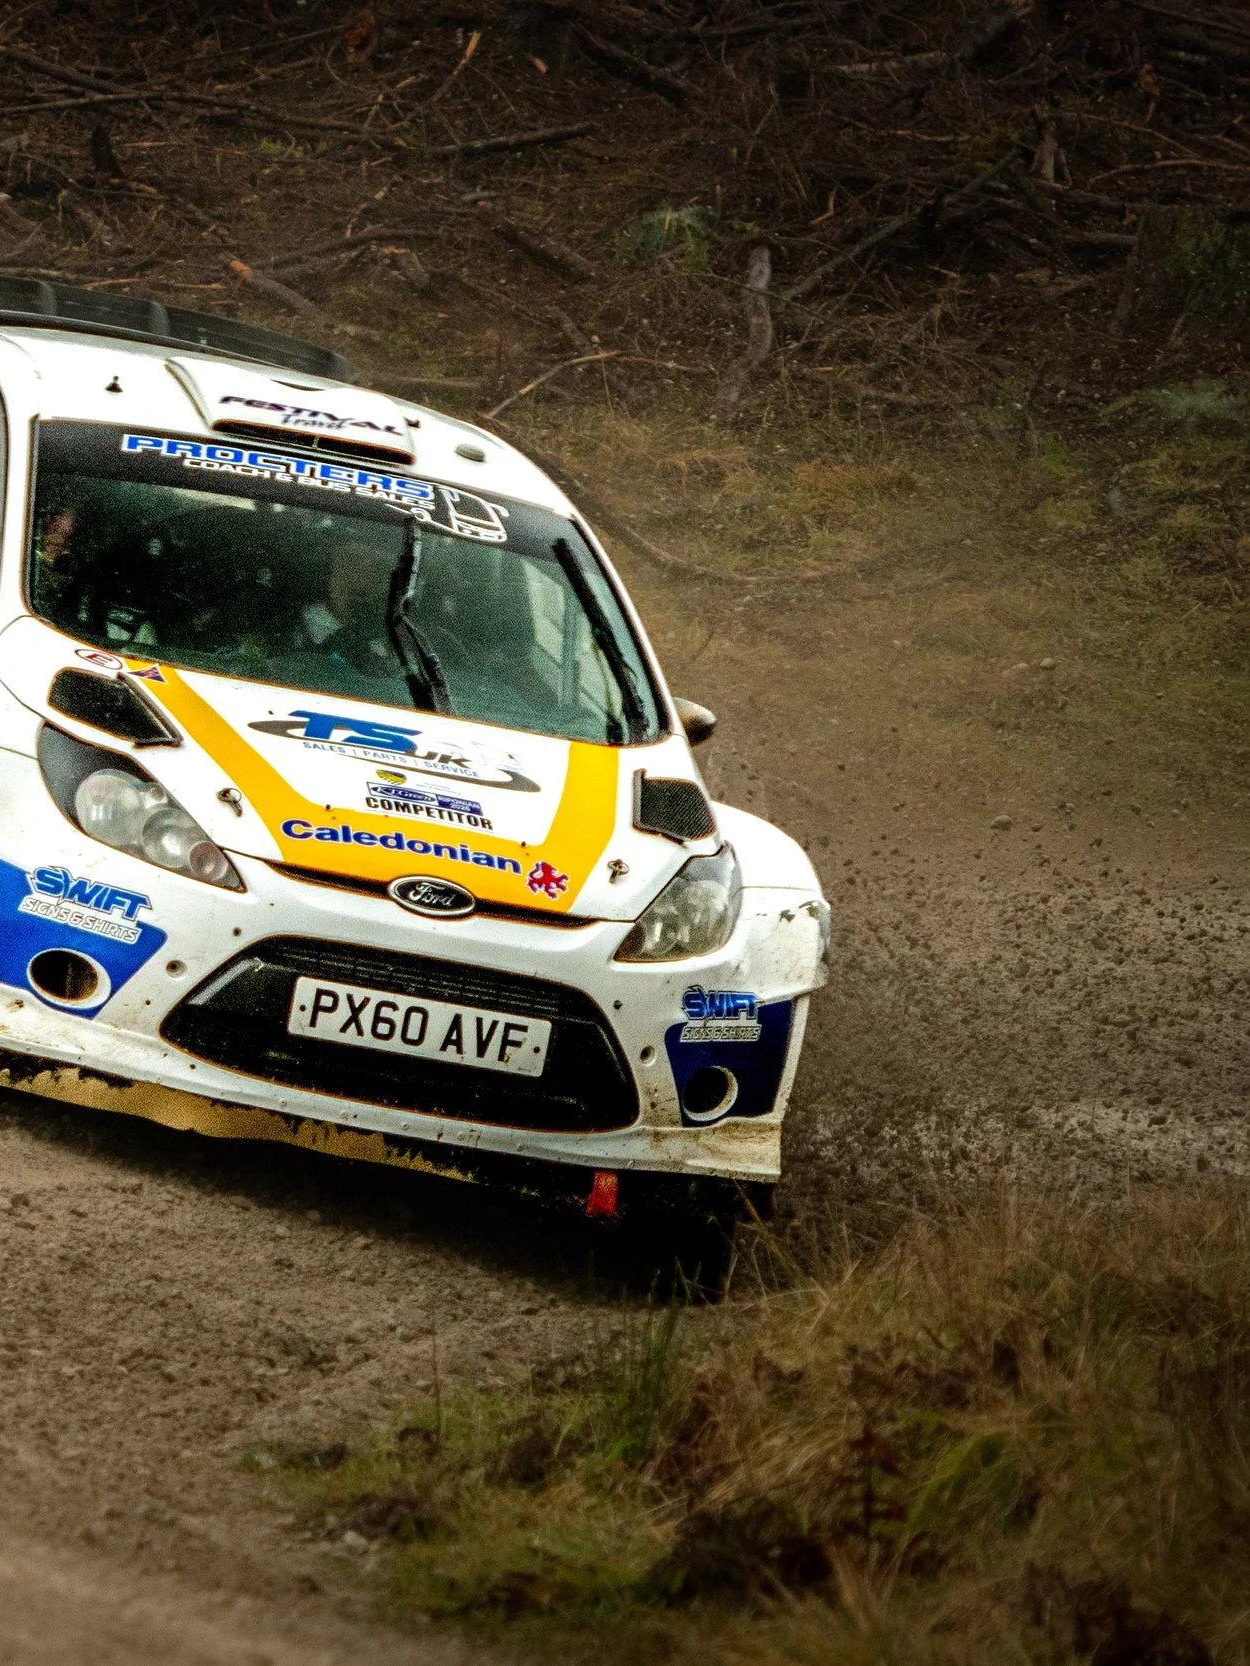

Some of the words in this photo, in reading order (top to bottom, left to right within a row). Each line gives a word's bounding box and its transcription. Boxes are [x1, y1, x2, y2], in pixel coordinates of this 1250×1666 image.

[219, 395, 403, 436] FESTIVAL
[121, 433, 436, 501] PROCTERS
[182, 458, 271, 479] COACH
[274, 468, 295, 483] &
[297, 474, 351, 493] BUS
[355, 484, 437, 510] SALES
[302, 742, 346, 754] SALES
[362, 750, 408, 764] PARTS
[423, 761, 480, 779] SERVICE
[365, 797, 493, 830] COMPETITOR
[281, 819, 522, 874] Caledonian
[32, 866, 152, 921] SWIFT
[409, 882, 457, 906] Ford
[22, 898, 71, 922] SIGNS
[69, 911, 84, 926] &
[81, 916, 139, 942] SHIRTS
[682, 985, 761, 1021] SWIFT
[309, 988, 429, 1046] PX60
[439, 1013, 529, 1063] AVF
[681, 1026, 713, 1041] SIGNS
